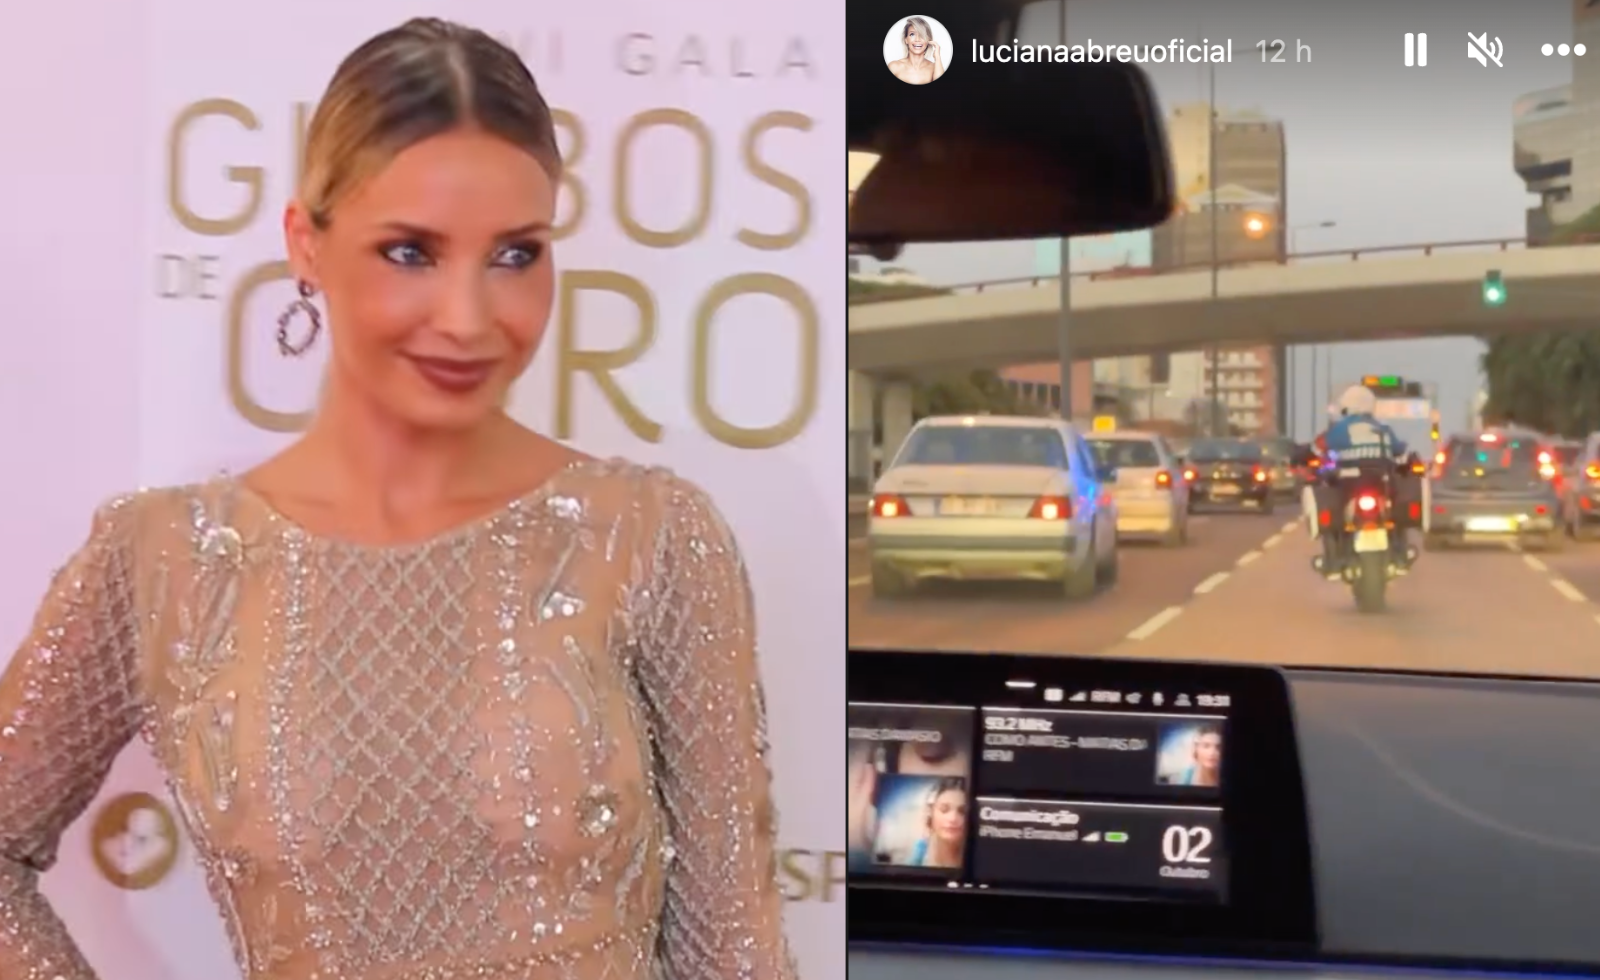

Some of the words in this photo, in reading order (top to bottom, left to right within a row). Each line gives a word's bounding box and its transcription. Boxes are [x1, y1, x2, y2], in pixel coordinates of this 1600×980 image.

[616, 32, 818, 78] GALA
[156, 254, 219, 299] DE
[225, 258, 819, 449] ORO
[1162, 825, 1212, 863] 02
